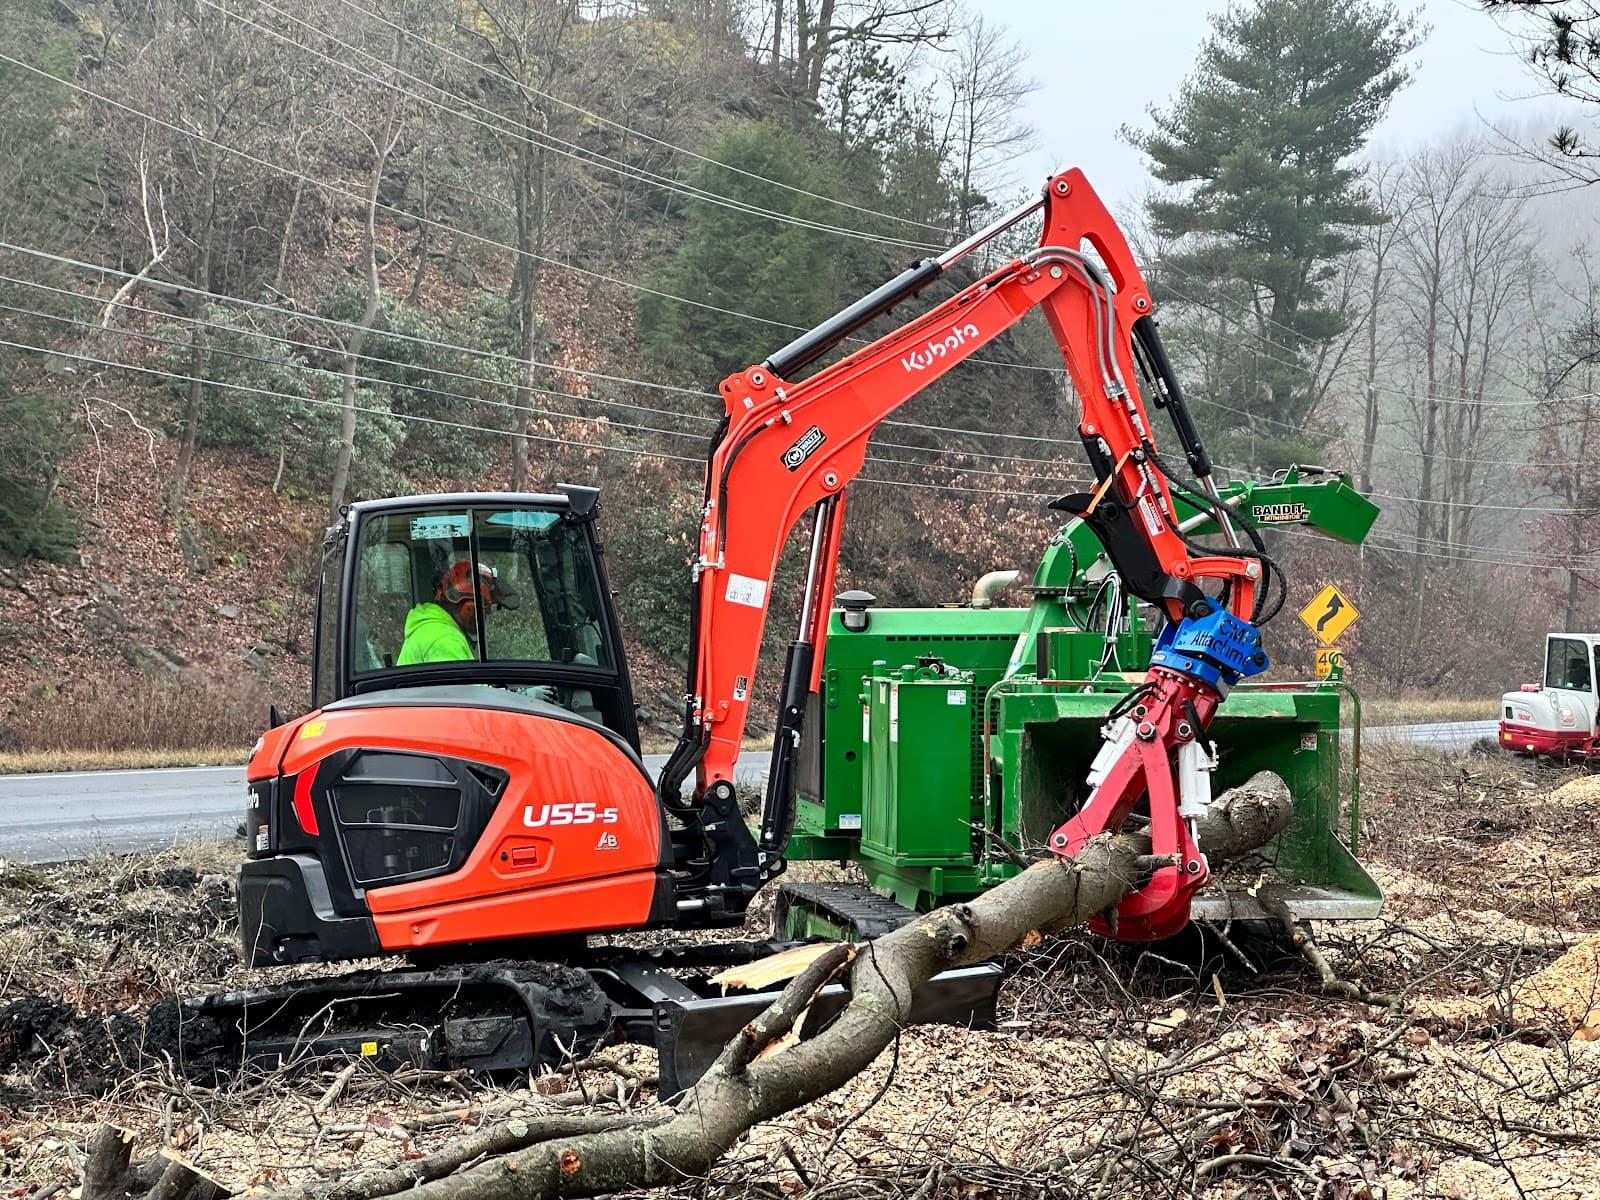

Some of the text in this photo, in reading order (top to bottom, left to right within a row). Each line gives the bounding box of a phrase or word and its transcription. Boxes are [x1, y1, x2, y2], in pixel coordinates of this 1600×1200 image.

[901, 324, 979, 372] Kubota
[1253, 504, 1304, 516] BANDIT
[1318, 651, 1339, 666] 40
[523, 803, 618, 827] U55-5
